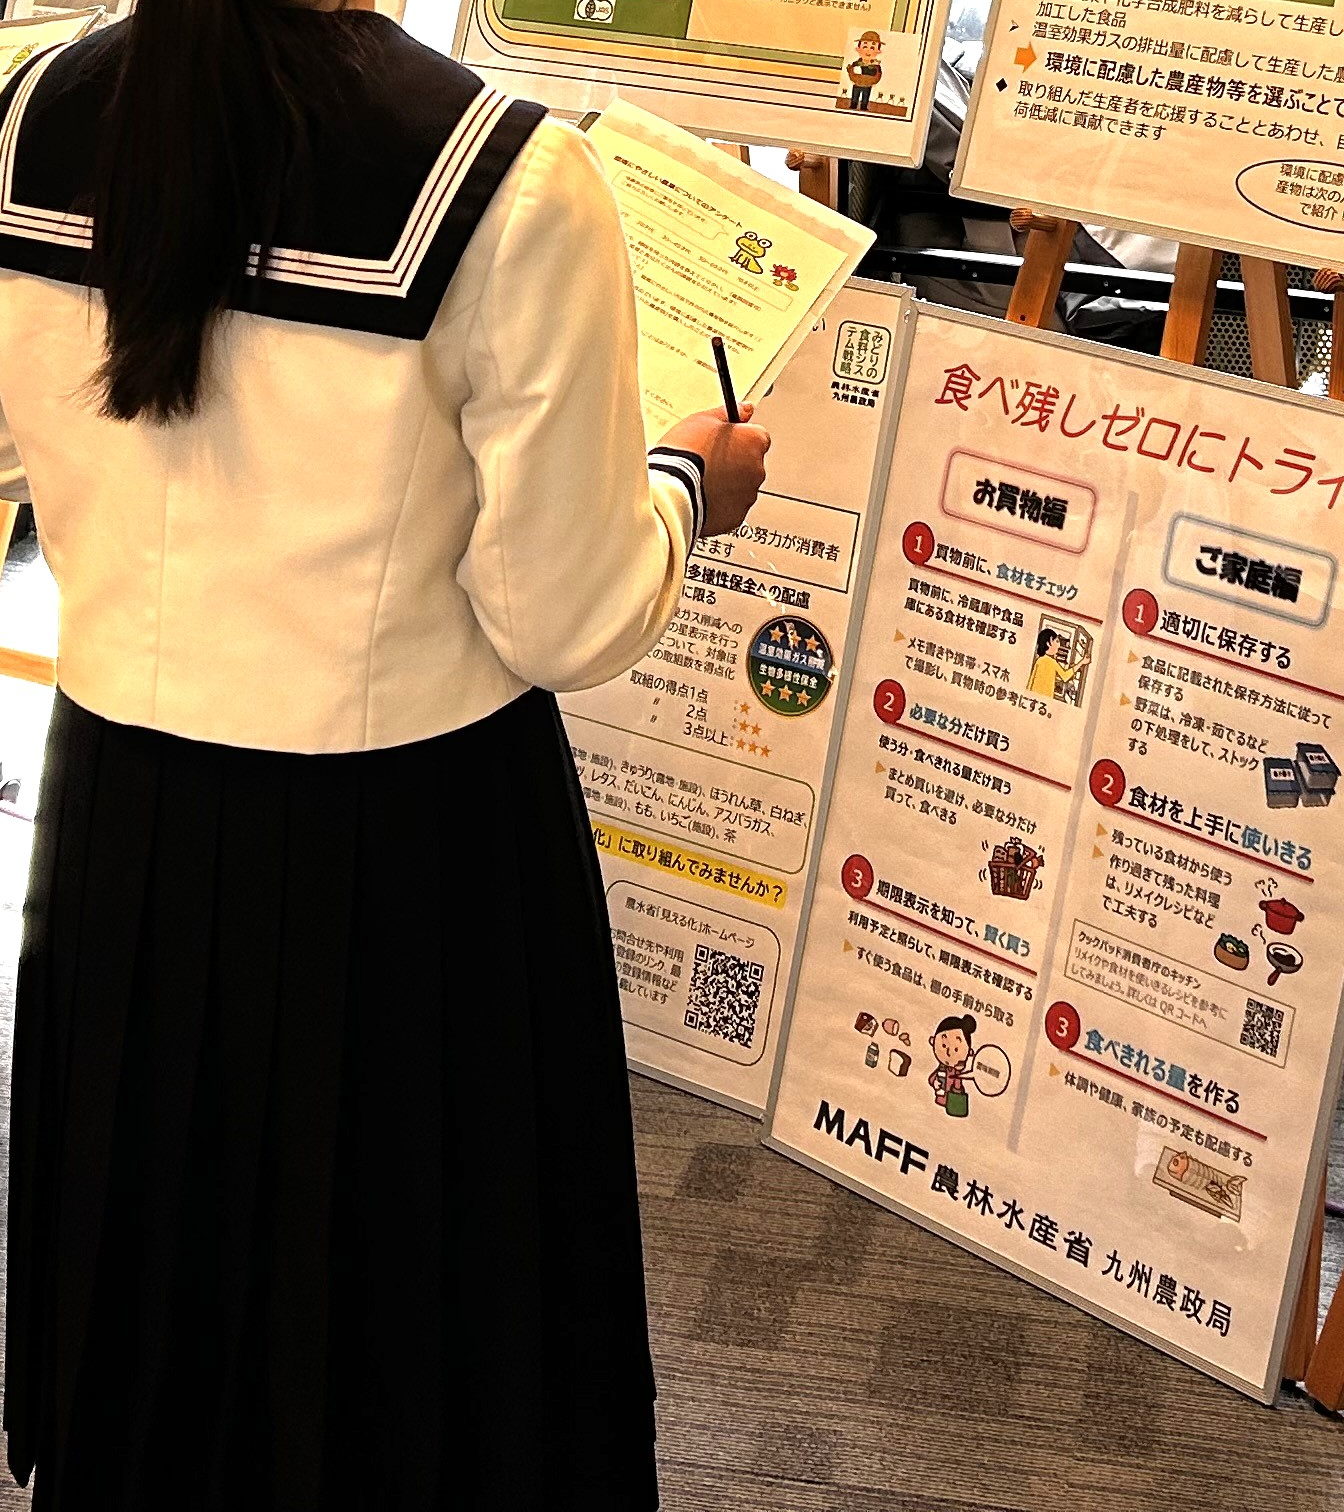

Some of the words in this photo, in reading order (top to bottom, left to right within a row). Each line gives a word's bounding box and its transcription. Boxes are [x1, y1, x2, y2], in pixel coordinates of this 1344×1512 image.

[1036, 2, 1126, 28] 加工した食品
[1014, 101, 1167, 141] 荷低減に貢献できます
[971, 475, 1069, 531] お買物編
[914, 535, 923, 554] 1
[935, 543, 1078, 601] 買物前に、食材をチェック
[1194, 546, 1303, 604] ご家庭編
[904, 597, 1017, 645] 庫にある食材を確認する
[908, 578, 1024, 628] 買物前に、冷蔵庫や食品
[1135, 604, 1144, 624] 1
[1160, 609, 1291, 670] 適切に保存する
[883, 693, 894, 711] 2
[1138, 675, 1184, 702] 保存する
[1141, 655, 1332, 730] 食品に記載された保存方法に従って
[910, 703, 1010, 751] 必要な分だけ買う
[1128, 738, 1148, 756] する
[1131, 718, 1260, 771] の下処理をして、ストック
[884, 786, 957, 825] 買って、食べきる
[1101, 774, 1114, 795] 2
[1129, 786, 1312, 871] 食材を上手に使いきる
[851, 869, 863, 887] 3
[1110, 854, 1221, 909] 作り過ぎて残った料理
[1112, 829, 1233, 886] 残っている食材から使う
[1103, 896, 1158, 928] で工夫する
[1106, 874, 1216, 929] は、リメイクレシピなど
[1056, 1017, 1069, 1037] 3
[1085, 1029, 1240, 1114] 食べきれる量を作る
[814, 1100, 929, 1178] MAFF
[931, 1164, 1090, 1269] 農林水産省
[1102, 1248, 1232, 1338] 九州農政局
